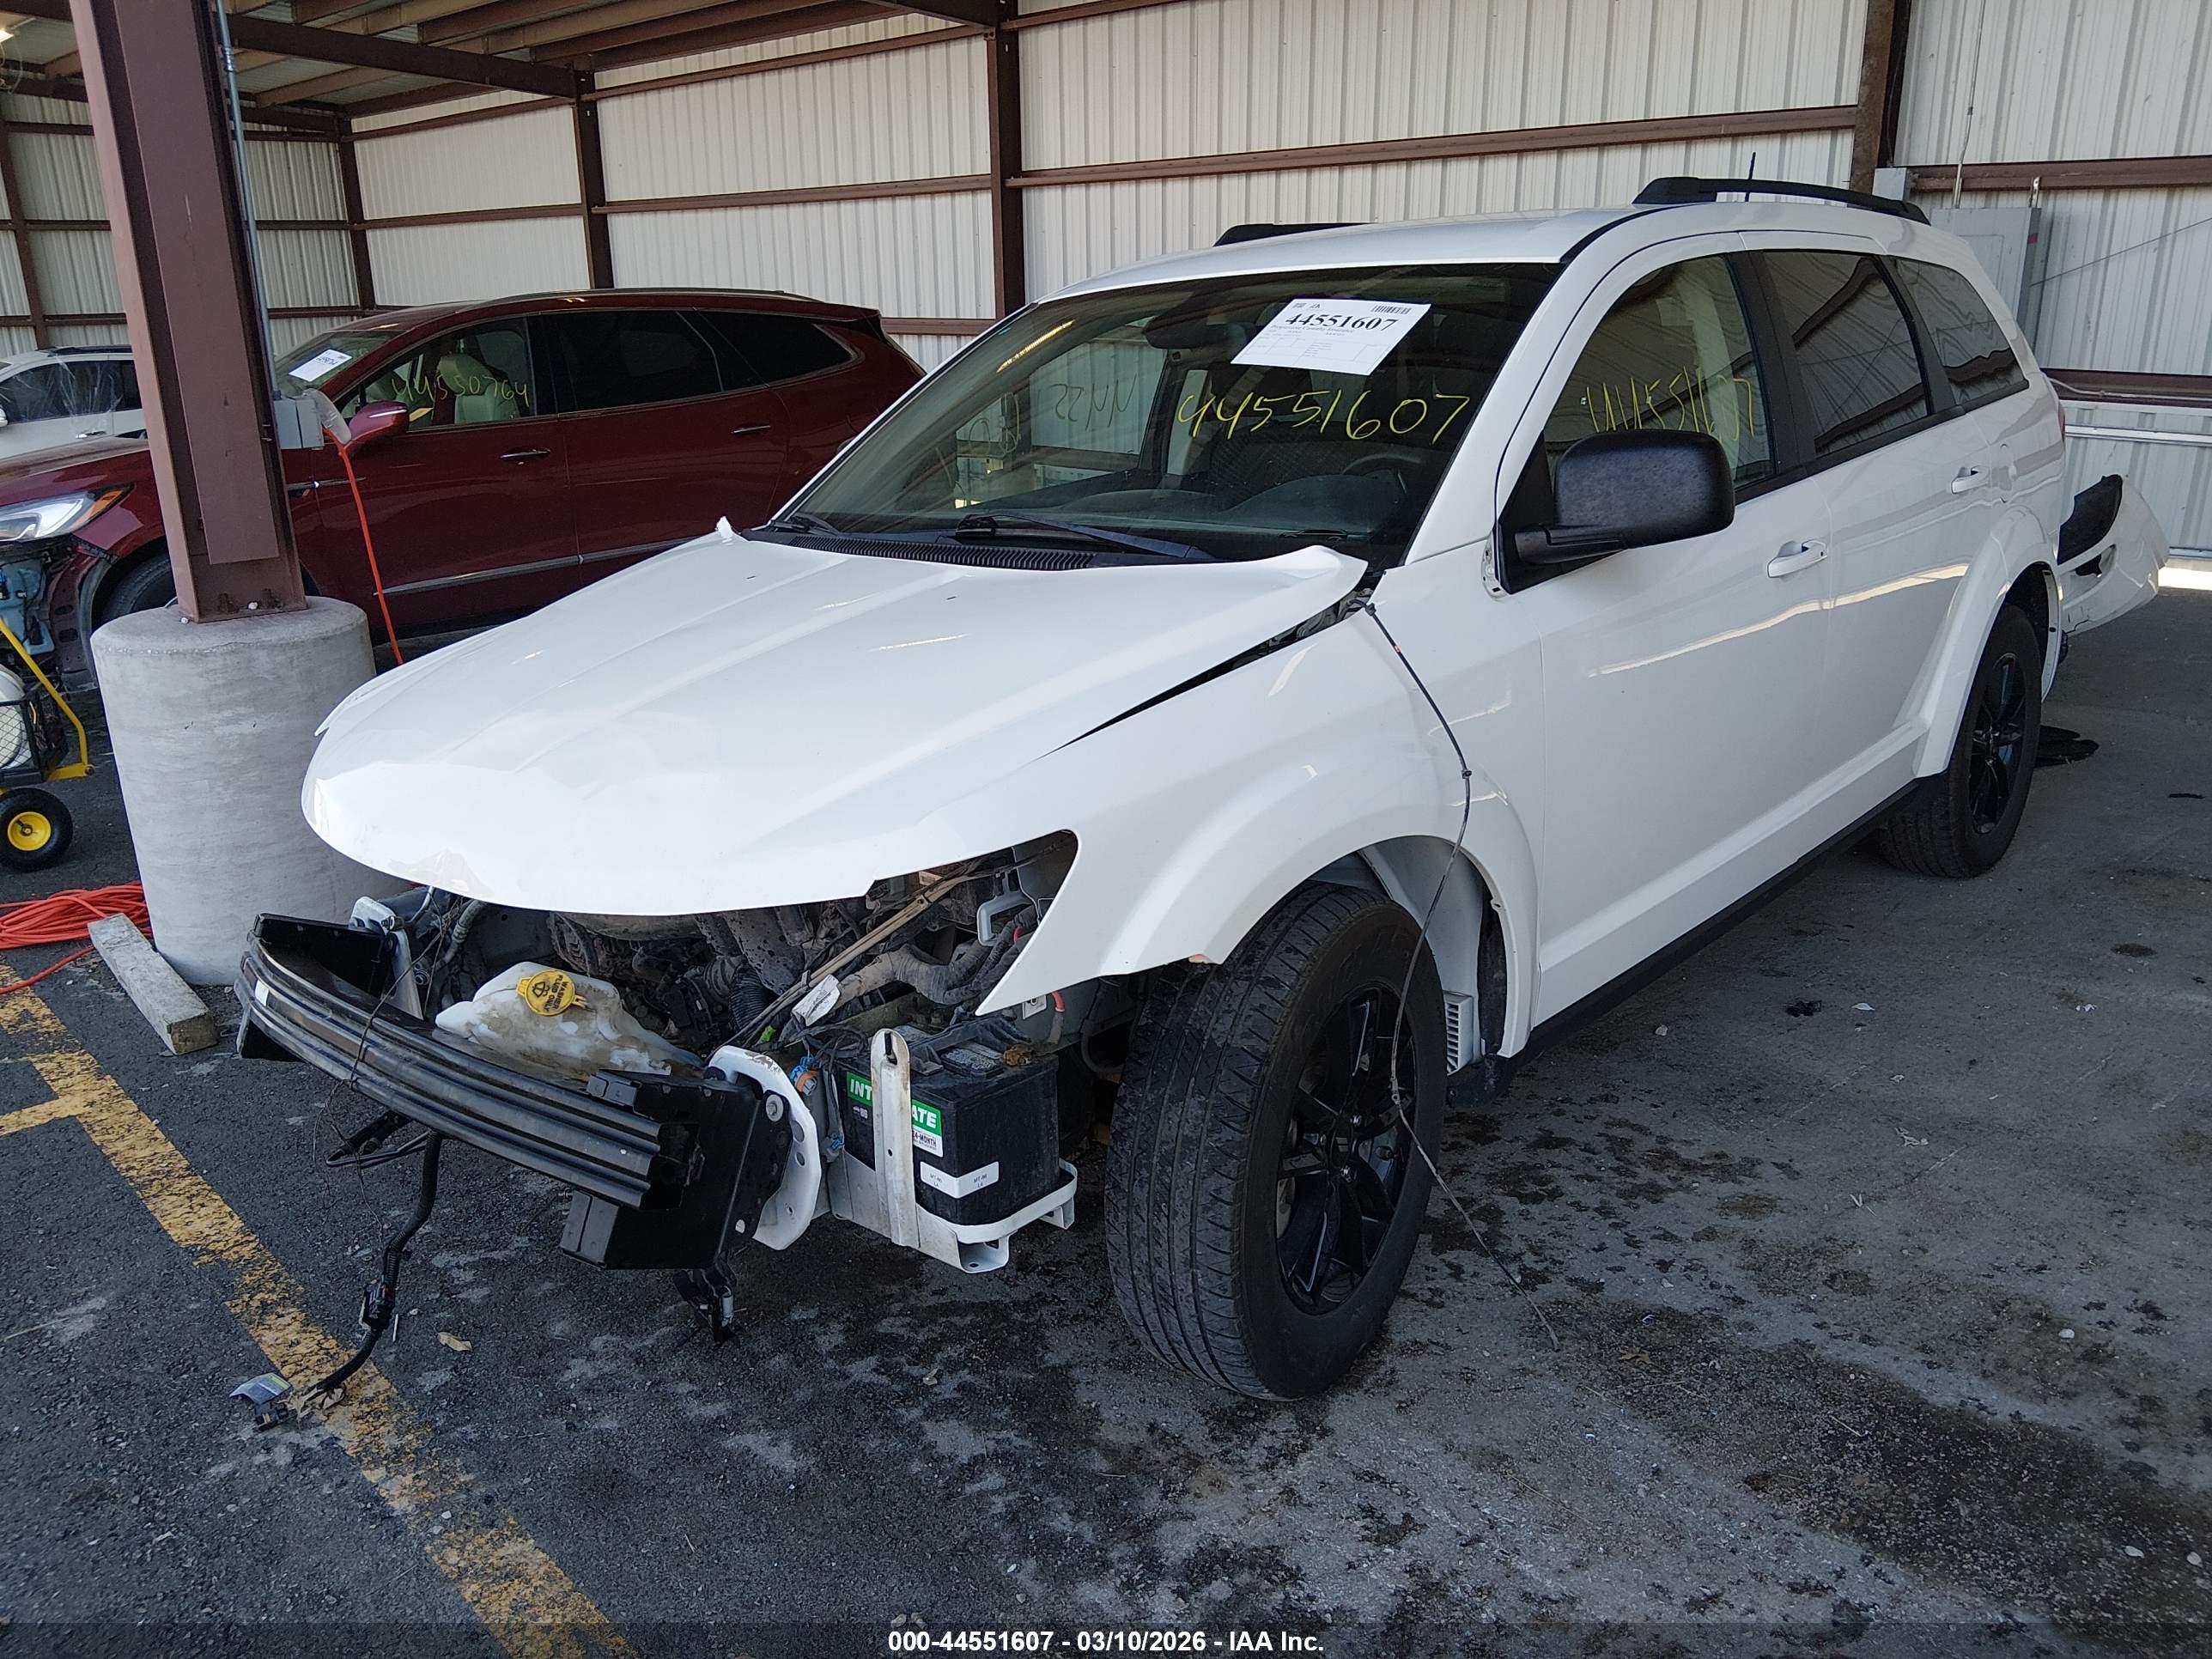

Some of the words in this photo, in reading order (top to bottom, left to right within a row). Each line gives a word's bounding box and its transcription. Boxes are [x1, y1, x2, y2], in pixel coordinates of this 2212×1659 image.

[1285, 313, 1399, 331] 44551607
[392, 374, 530, 408] 44550764
[1177, 389, 1471, 446] 44551607
